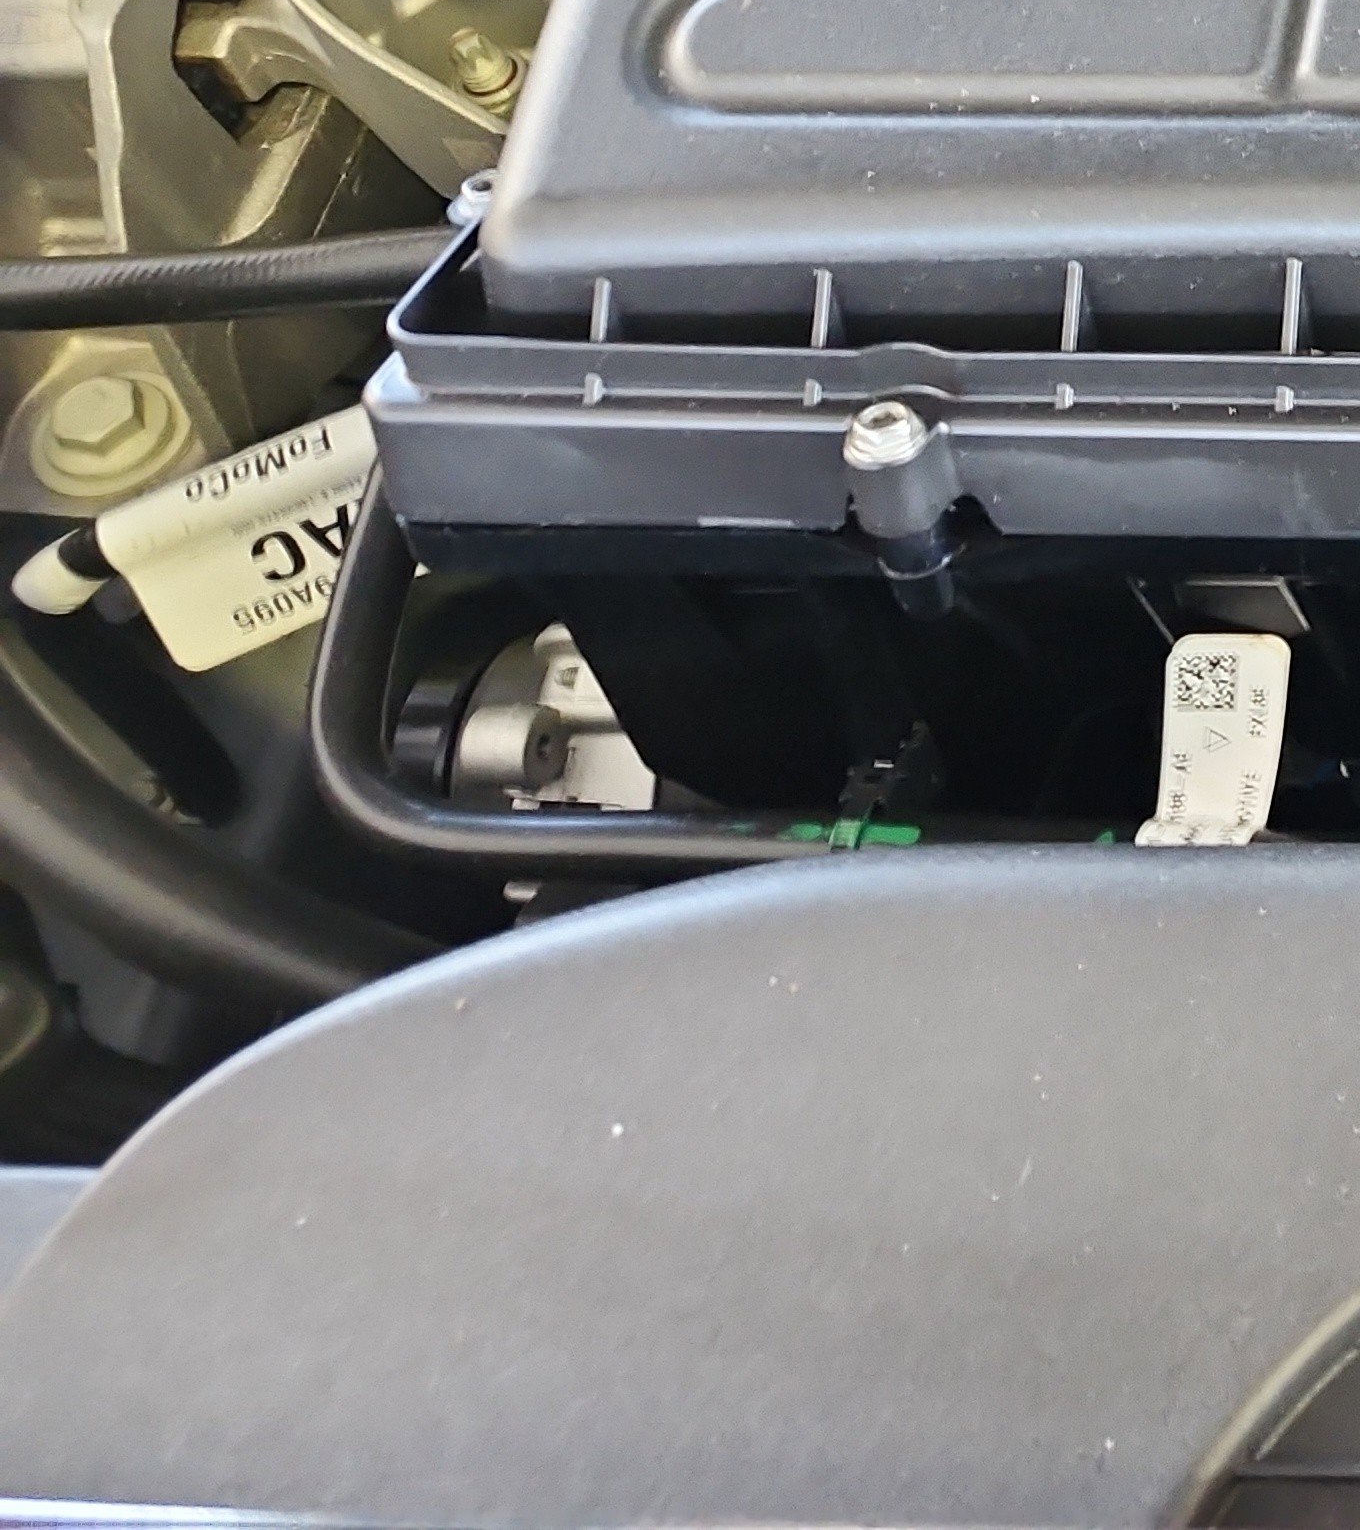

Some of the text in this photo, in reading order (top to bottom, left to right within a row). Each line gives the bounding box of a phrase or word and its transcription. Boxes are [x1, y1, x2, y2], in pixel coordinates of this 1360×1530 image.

[183, 425, 335, 505] FoMoCo
[250, 502, 360, 590] AC
[231, 575, 335, 637] 9A095
